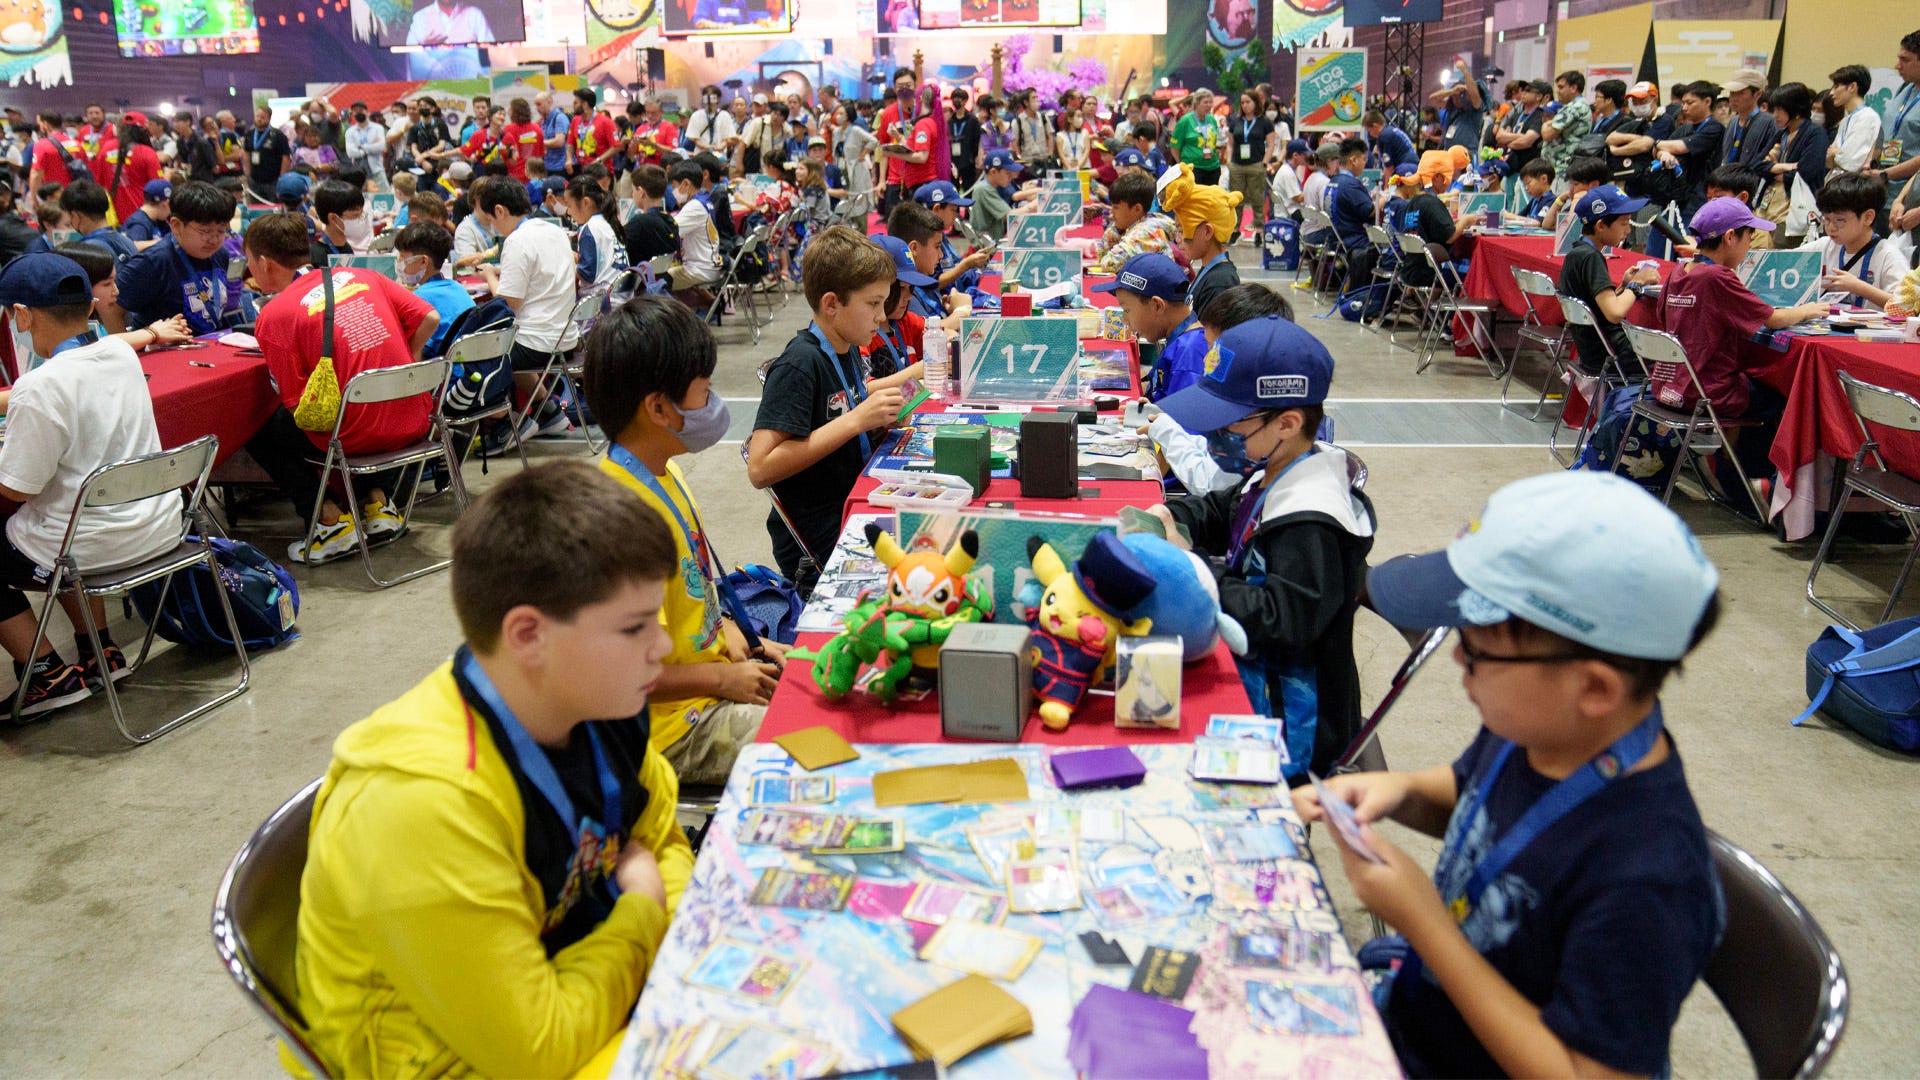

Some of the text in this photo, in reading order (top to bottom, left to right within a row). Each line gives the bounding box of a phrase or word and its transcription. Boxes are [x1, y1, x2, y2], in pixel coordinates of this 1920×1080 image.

[1319, 77, 1349, 99] AREA
[1051, 201, 1072, 215] 23
[1025, 227, 1047, 243] 21
[1029, 266, 1062, 287] 19
[1765, 268, 1800, 290] 10
[1000, 343, 1049, 374] 17
[1262, 379, 1304, 388] YOKOHAMA
